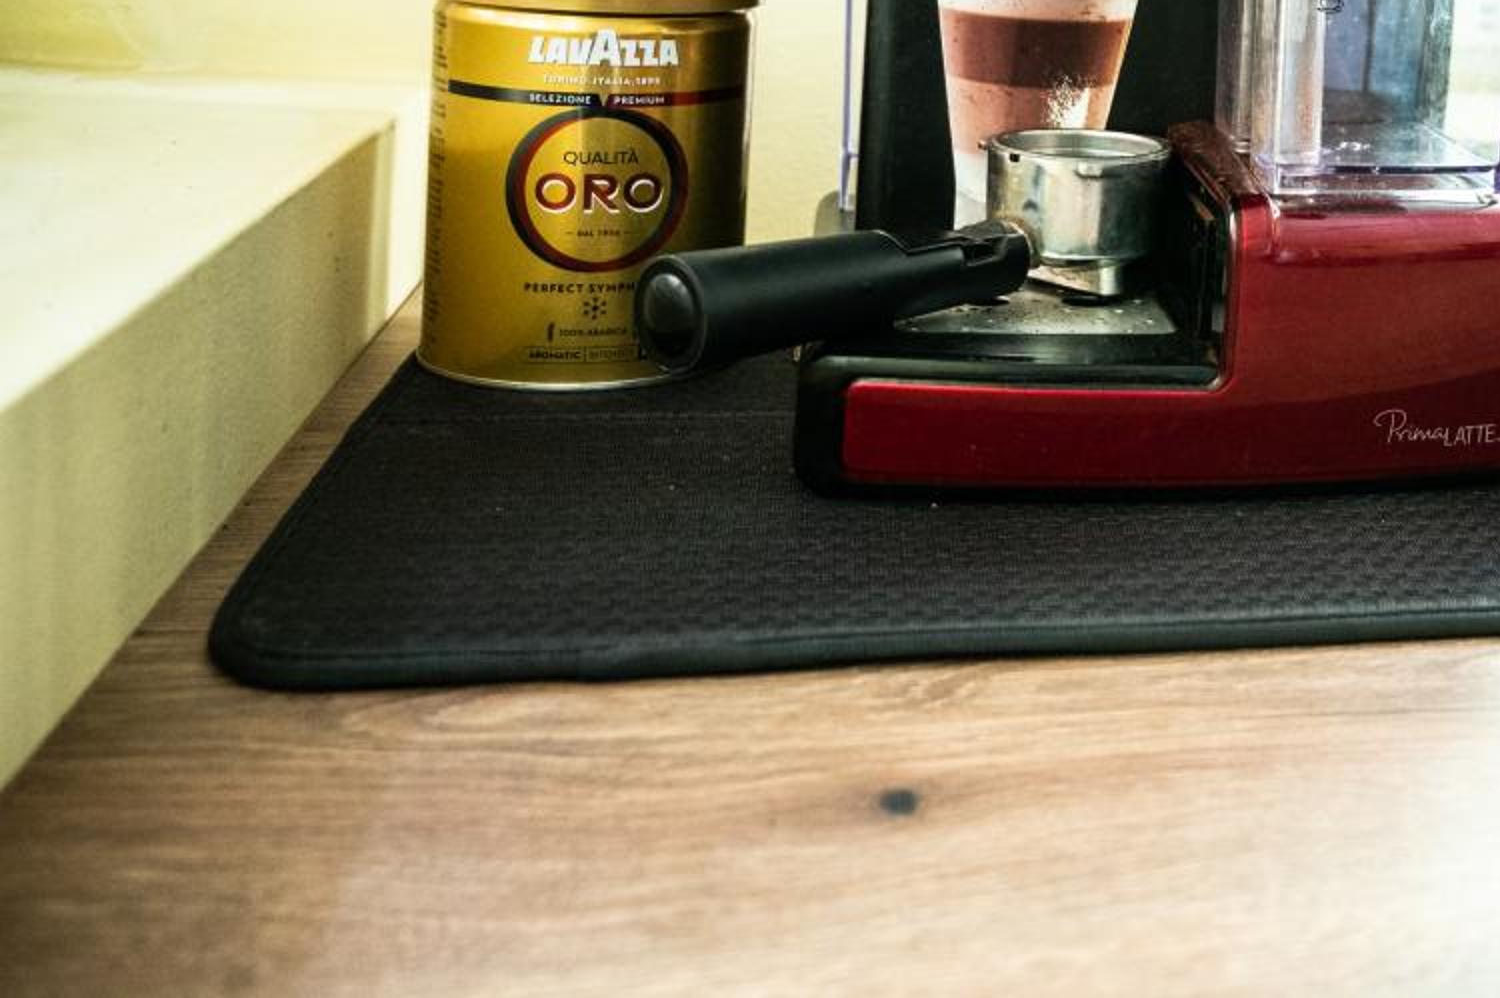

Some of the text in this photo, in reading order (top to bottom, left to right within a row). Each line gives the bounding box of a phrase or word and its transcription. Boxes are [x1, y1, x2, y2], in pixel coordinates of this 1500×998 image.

[528, 27, 679, 67] LAVAZZA
[529, 93, 665, 105] SELEZIONE PREMIUM
[563, 147, 640, 166] QUALITÀ
[534, 173, 665, 214] ORO
[524, 283, 585, 294] PERFECT
[528, 351, 581, 360] AROMATIC
